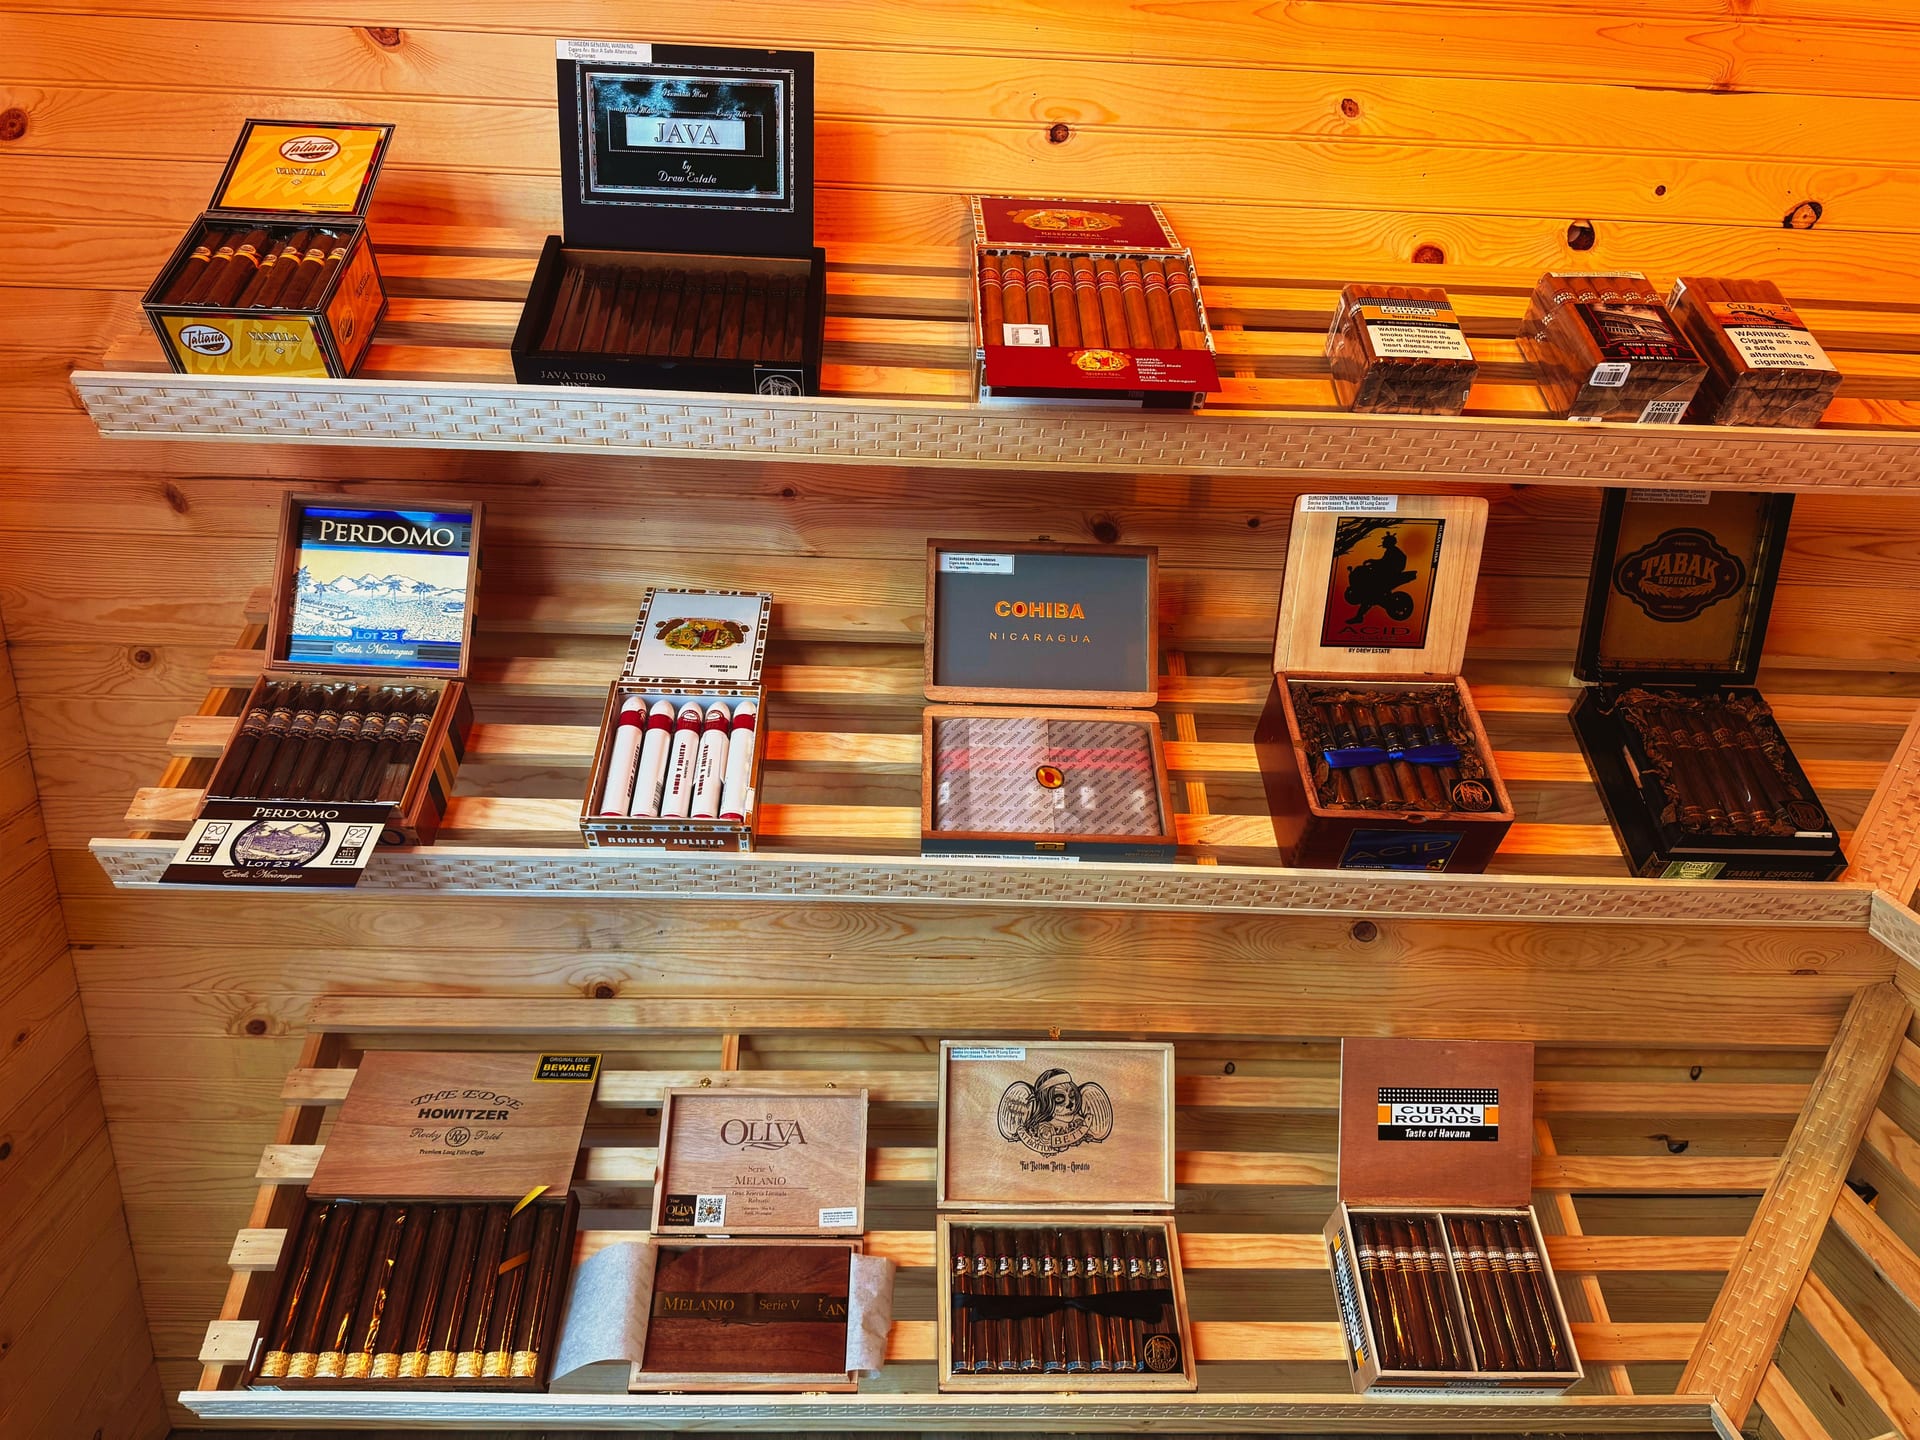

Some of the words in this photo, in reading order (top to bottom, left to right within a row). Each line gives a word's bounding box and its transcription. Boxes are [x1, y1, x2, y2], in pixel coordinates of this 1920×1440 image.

[654, 122, 719, 144] JAVA
[284, 140, 335, 156] Tatiana
[276, 167, 326, 176] VANILLA
[682, 160, 692, 173] by
[657, 170, 684, 182] Drew
[687, 172, 717, 184] Estate
[1727, 303, 1776, 316] CUBAN
[181, 330, 225, 348] Tatiana
[247, 331, 301, 342] VANILLA
[1618, 346, 1679, 356] SWEET
[541, 371, 570, 380] JAVA
[573, 372, 606, 381] TORO
[319, 520, 454, 547] PERDOMO
[1641, 553, 1720, 579] TABAK
[1658, 576, 1697, 586] ESPECIAL
[994, 600, 1086, 620] COHIBA
[356, 631, 378, 640] LOT
[381, 631, 398, 641] 23
[989, 632, 1092, 643] NICARAGUA
[1338, 626, 1411, 635] ACID
[365, 643, 415, 660] Nicaragua
[1004, 731, 1021, 746] COHIBA
[999, 746, 1016, 761] COHIBA
[1013, 745, 1031, 760] COHIBA
[673, 774, 681, 795] ROMEO
[677, 743, 687, 766] JULIETA
[697, 774, 705, 796] ROMEO
[702, 744, 710, 768] JULIETA
[1009, 761, 1026, 776] COHIBA
[1004, 776, 1021, 791] COHIBA
[1018, 776, 1036, 791] COHIBA
[999, 792, 1017, 808] COHIBA
[1014, 792, 1032, 807] COHIBA
[252, 807, 339, 820] PERDOMO
[1009, 808, 1027, 824] COHIBA
[208, 825, 226, 835] 90
[349, 829, 367, 839] 92
[673, 838, 725, 846] JULIETA
[1347, 841, 1452, 862] ACID
[252, 869, 303, 882] Nicaragua
[1726, 870, 1761, 878] TABAK
[410, 1090, 459, 1107] THE
[462, 1089, 524, 1110] EDGE
[418, 1108, 509, 1120] HOWITZER
[1401, 1106, 1474, 1115] CUBAN
[1395, 1115, 1481, 1124] ROUNDS
[409, 1128, 441, 1142] Rocky
[474, 1129, 504, 1140] Patel
[720, 1114, 808, 1149] OLIVA
[1405, 1128, 1426, 1138] Taste
[1428, 1128, 1438, 1138] of
[1439, 1129, 1471, 1138] Havana
[767, 1165, 775, 1173] V
[1020, 1161, 1029, 1172] Fat
[1030, 1161, 1050, 1172] Bottom
[1050, 1161, 1066, 1173] Betty
[735, 1175, 787, 1185] MELANIO
[666, 1203, 694, 1217] OLIVA
[664, 1297, 735, 1312] MELANIO
[759, 1300, 787, 1310] Serie
[791, 1300, 800, 1310] V
